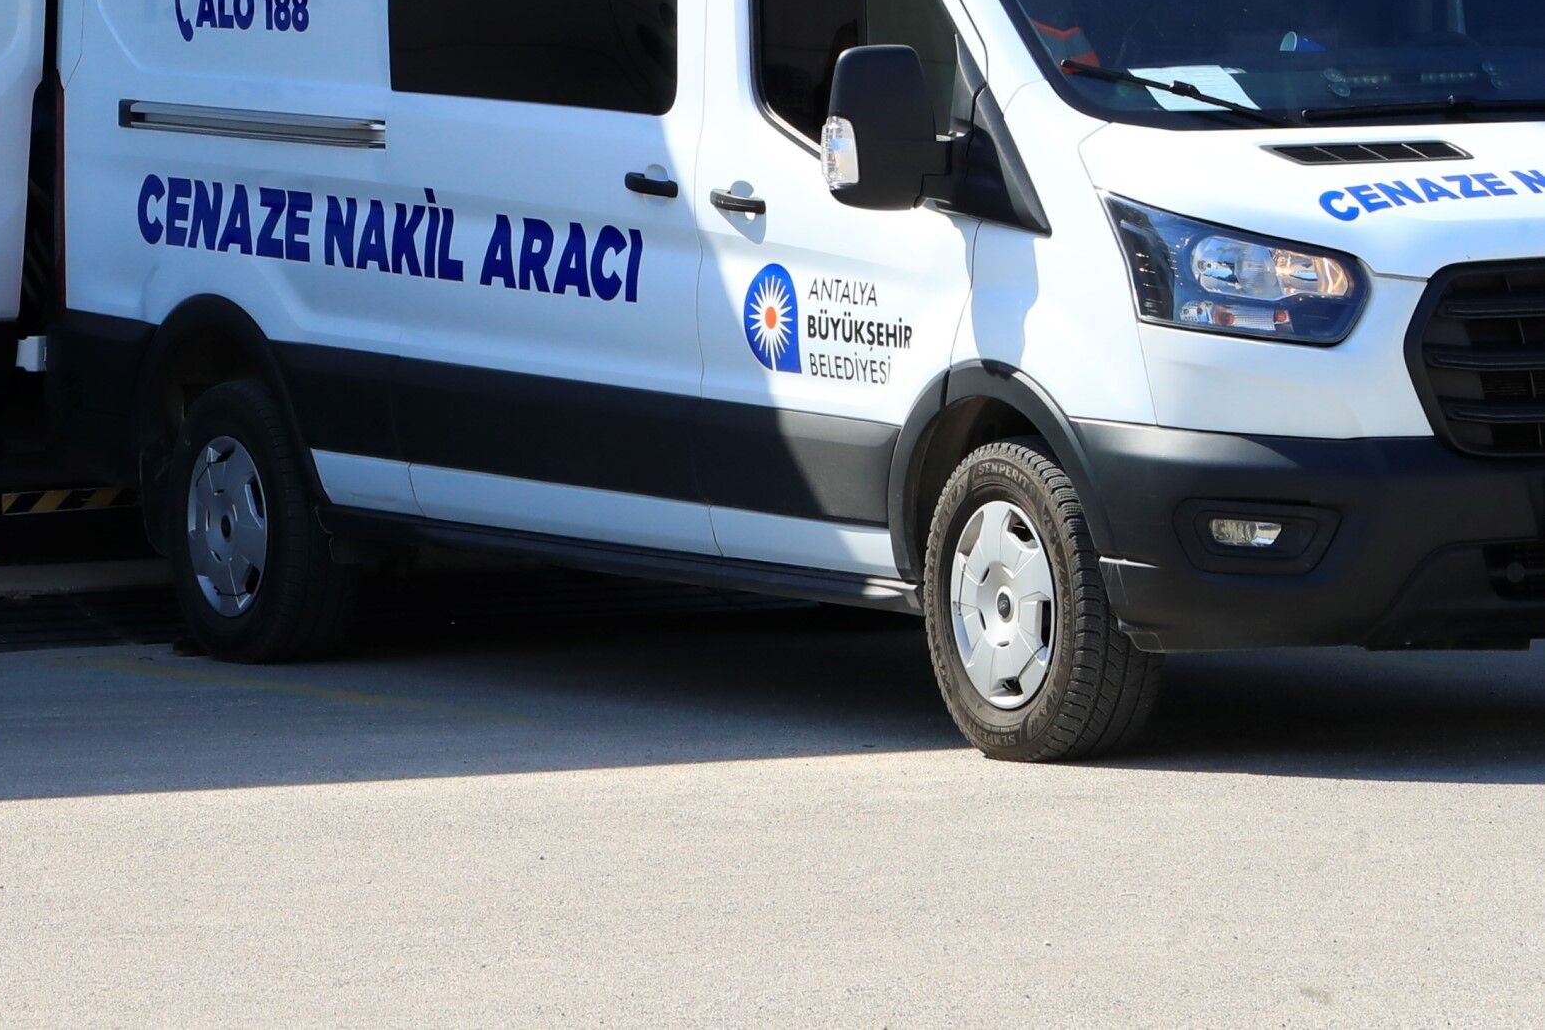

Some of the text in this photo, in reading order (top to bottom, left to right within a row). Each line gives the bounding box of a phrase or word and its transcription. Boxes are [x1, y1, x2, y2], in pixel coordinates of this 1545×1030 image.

[1318, 172, 1518, 221] CENAZE
[137, 173, 644, 304] CENAZE NAKİL ARACI
[808, 277, 878, 307] ANTALYA
[807, 309, 913, 352] BÜYÜKŞEHİR
[808, 351, 892, 385] BELEDİYESİ
[977, 462, 1030, 489] SEMPERIT
